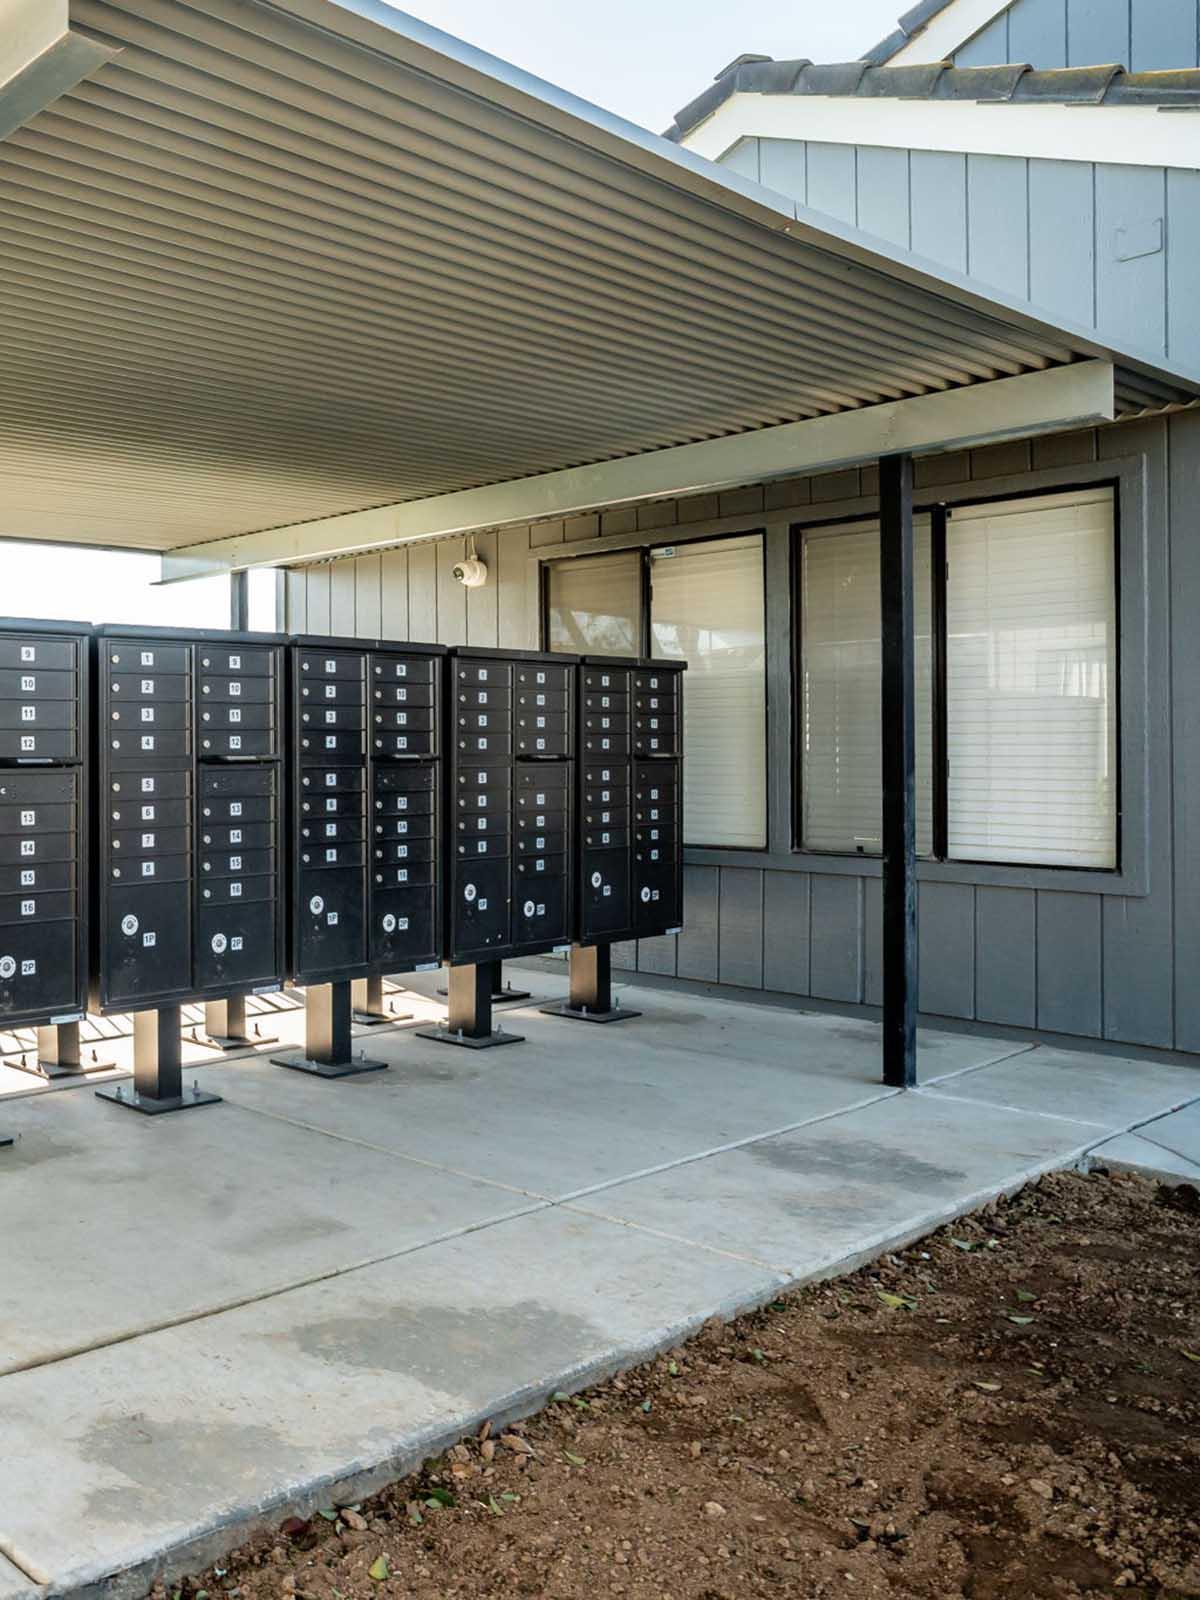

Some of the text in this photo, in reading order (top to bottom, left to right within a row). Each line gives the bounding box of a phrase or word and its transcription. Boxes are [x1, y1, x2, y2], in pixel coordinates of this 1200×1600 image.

[24, 649, 31, 659] 9
[23, 679, 34, 688] 10
[230, 684, 240, 693] 10
[24, 709, 33, 718] 11
[231, 711, 240, 719] 11
[23, 738, 34, 748] 12
[231, 737, 240, 746] 12
[231, 804, 241, 814] 13
[23, 813, 34, 823] 13
[232, 831, 241, 840] 14
[23, 843, 34, 853] 14
[231, 858, 241, 867] 15
[23, 872, 34, 882] 15
[23, 902, 34, 913] 16
[144, 934, 155, 944] 1P
[232, 938, 242, 948] 2P
[23, 962, 35, 973] 2P
